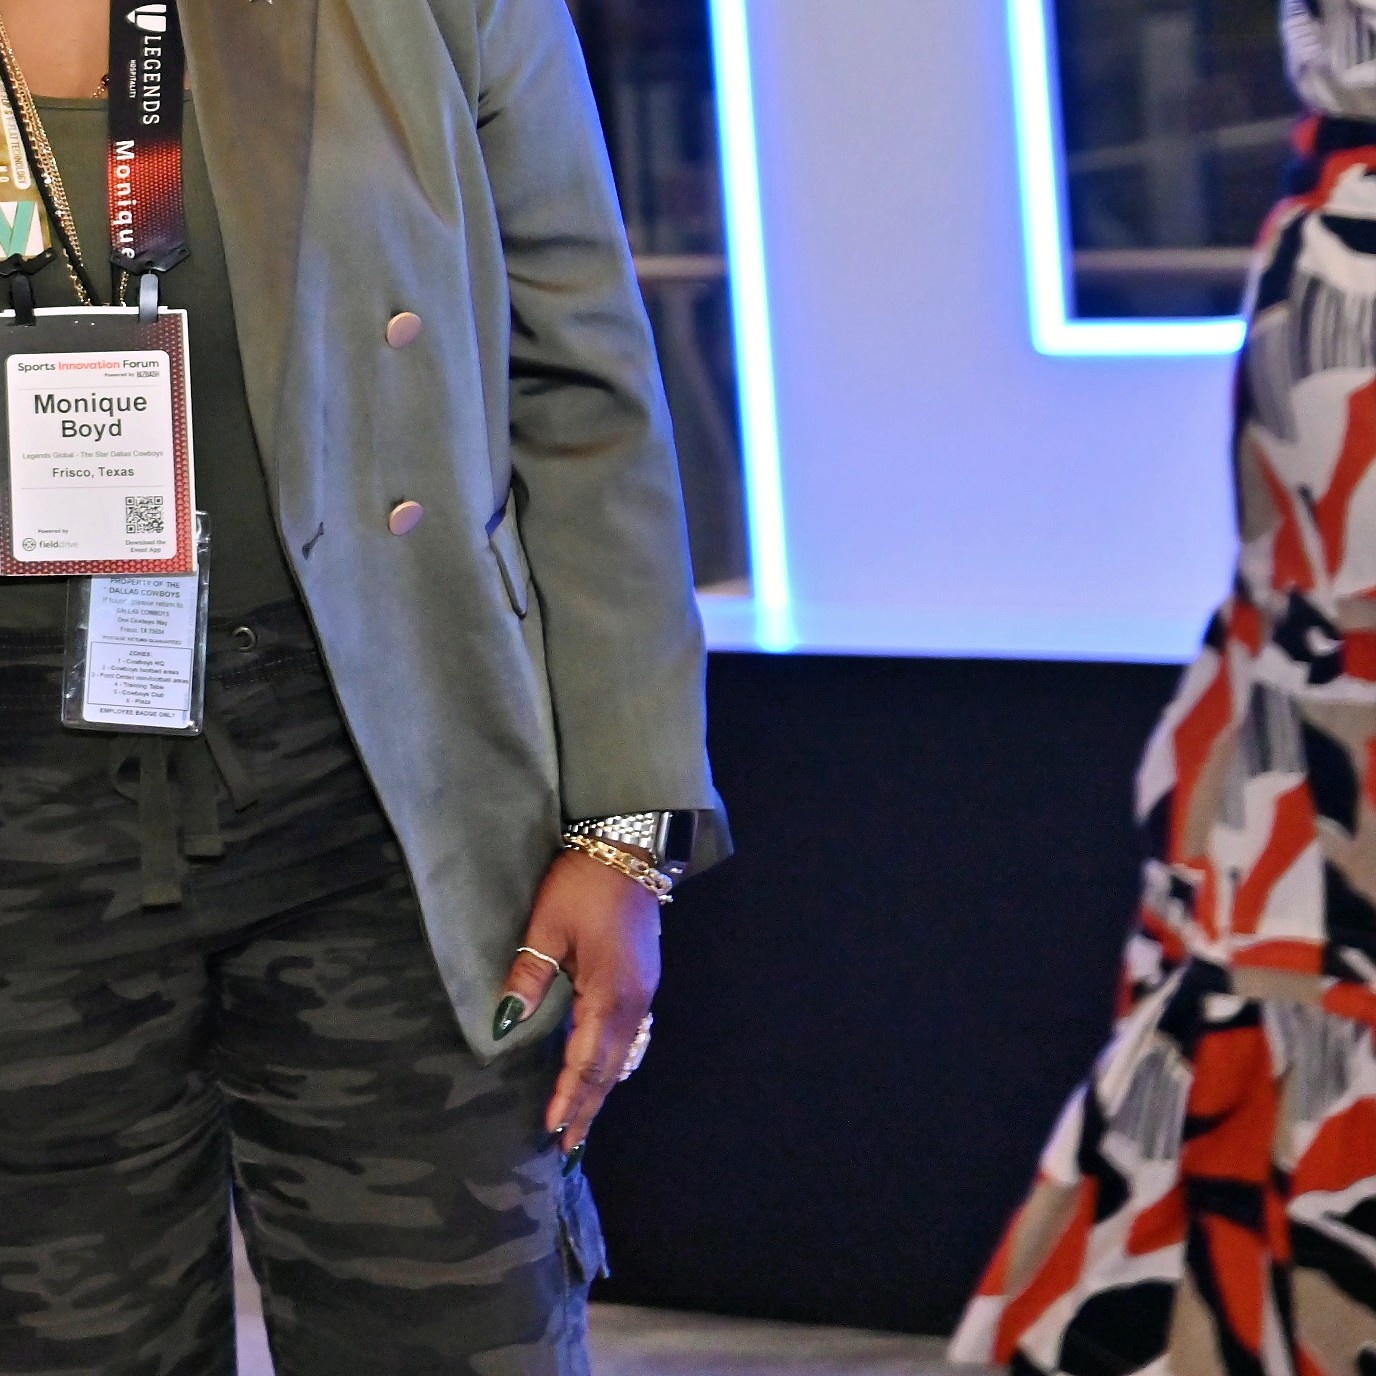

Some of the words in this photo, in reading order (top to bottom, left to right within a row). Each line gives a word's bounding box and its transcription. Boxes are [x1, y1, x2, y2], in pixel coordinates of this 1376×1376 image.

[128, 59, 137, 99] HOSPITALITY
[142, 34, 162, 126] LEGENDS
[112, 139, 137, 259] Monique
[18, 362, 56, 373] Sports
[58, 360, 120, 370] Innovation
[123, 359, 159, 368] Forum
[34, 393, 147, 417] Monique
[61, 419, 122, 442] Boyd
[52, 467, 95, 478] Frisco,
[98, 466, 134, 477] Texas
[109, 587, 139, 595] DALLAS
[141, 589, 180, 598] COWBOYS
